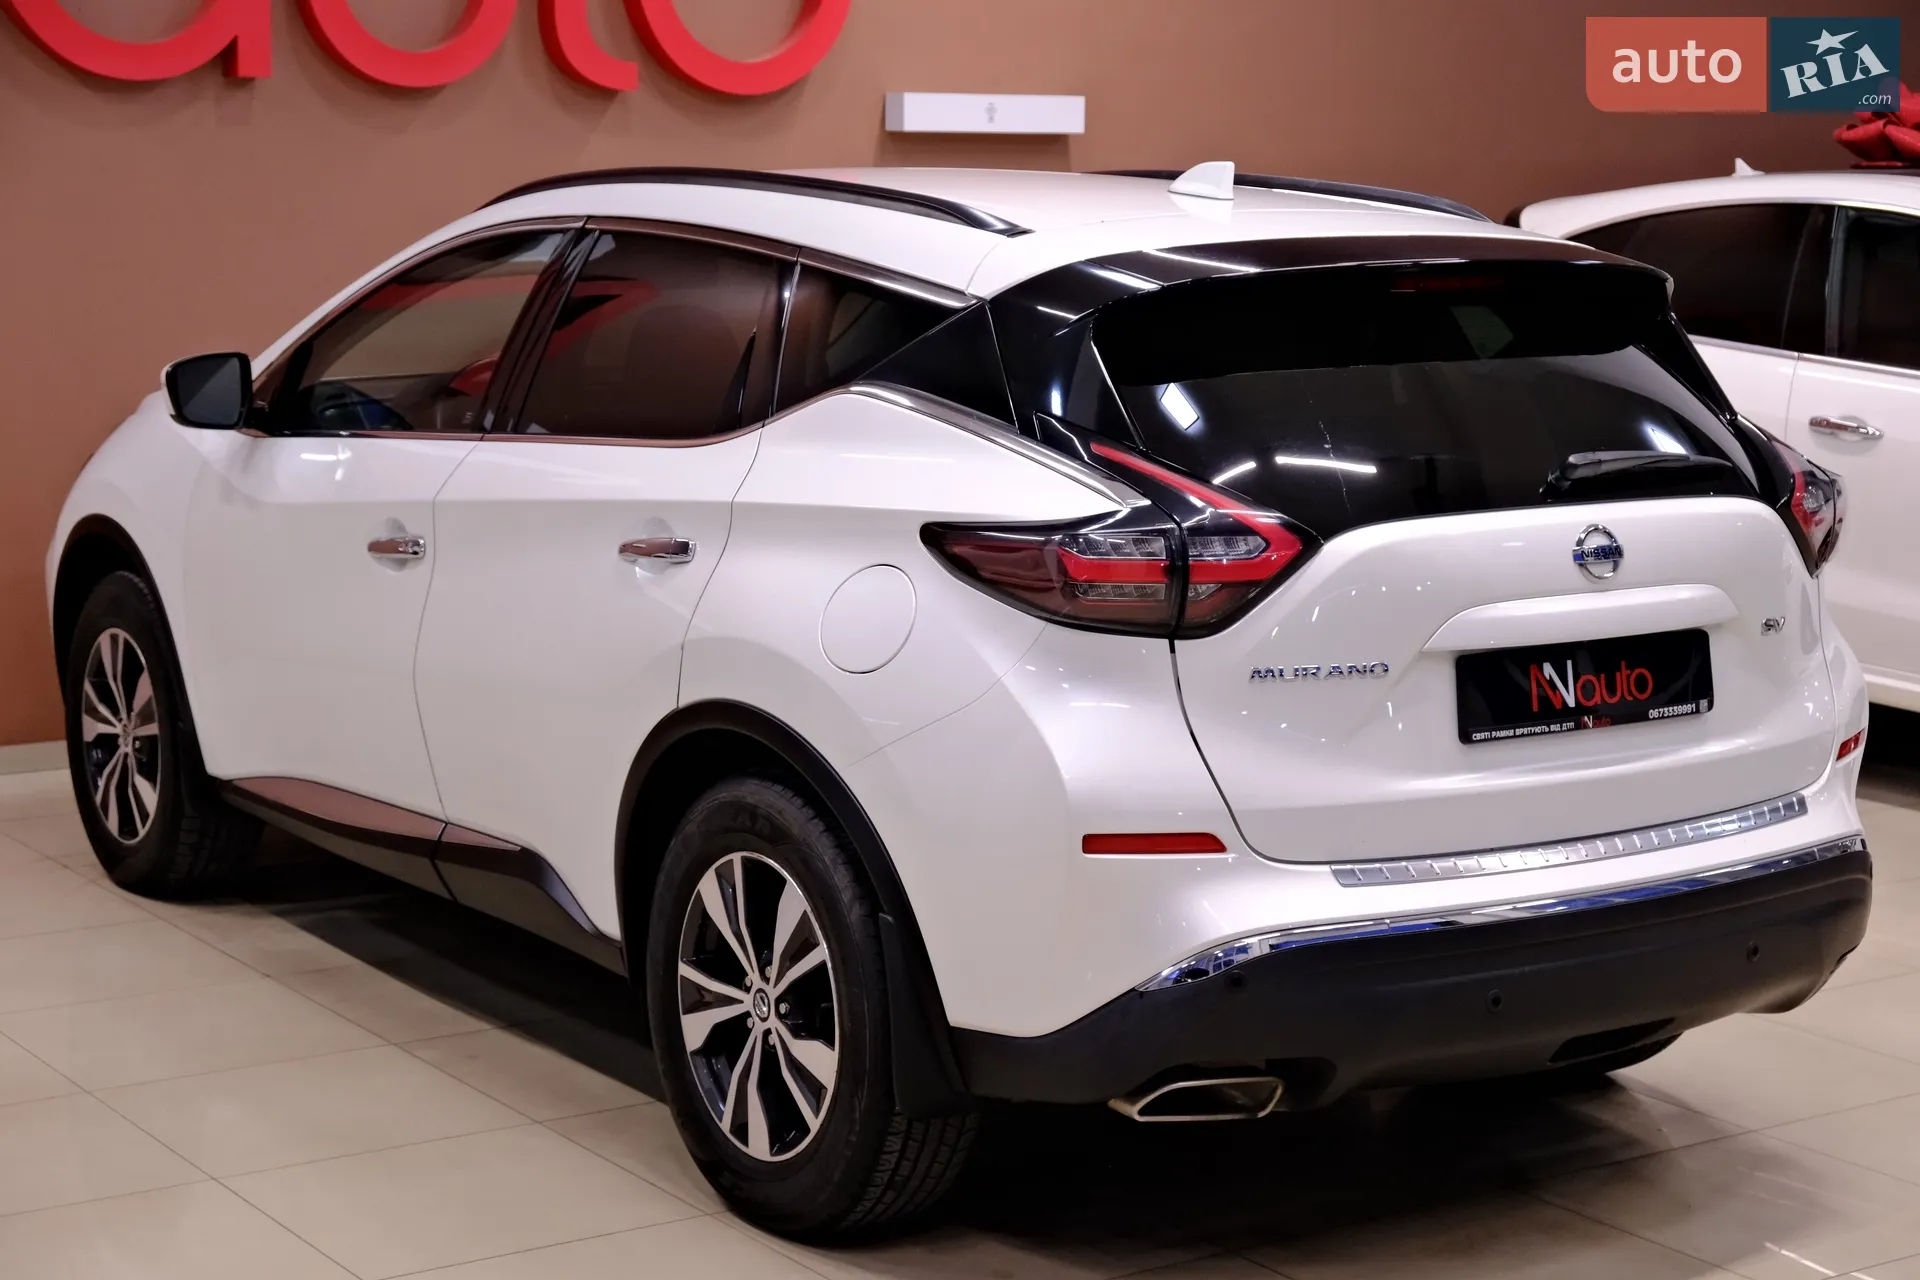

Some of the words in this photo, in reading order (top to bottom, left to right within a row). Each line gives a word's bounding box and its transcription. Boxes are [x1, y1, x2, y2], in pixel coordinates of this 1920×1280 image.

[1580, 546, 1622, 560] NISSAN
[1761, 616, 1786, 636] SV
[1248, 661, 1389, 682] MURANO
[1648, 703, 1696, 719] 0673339991
[1491, 729, 1515, 738] РАМКИ
[1550, 723, 1561, 732] ВІД
